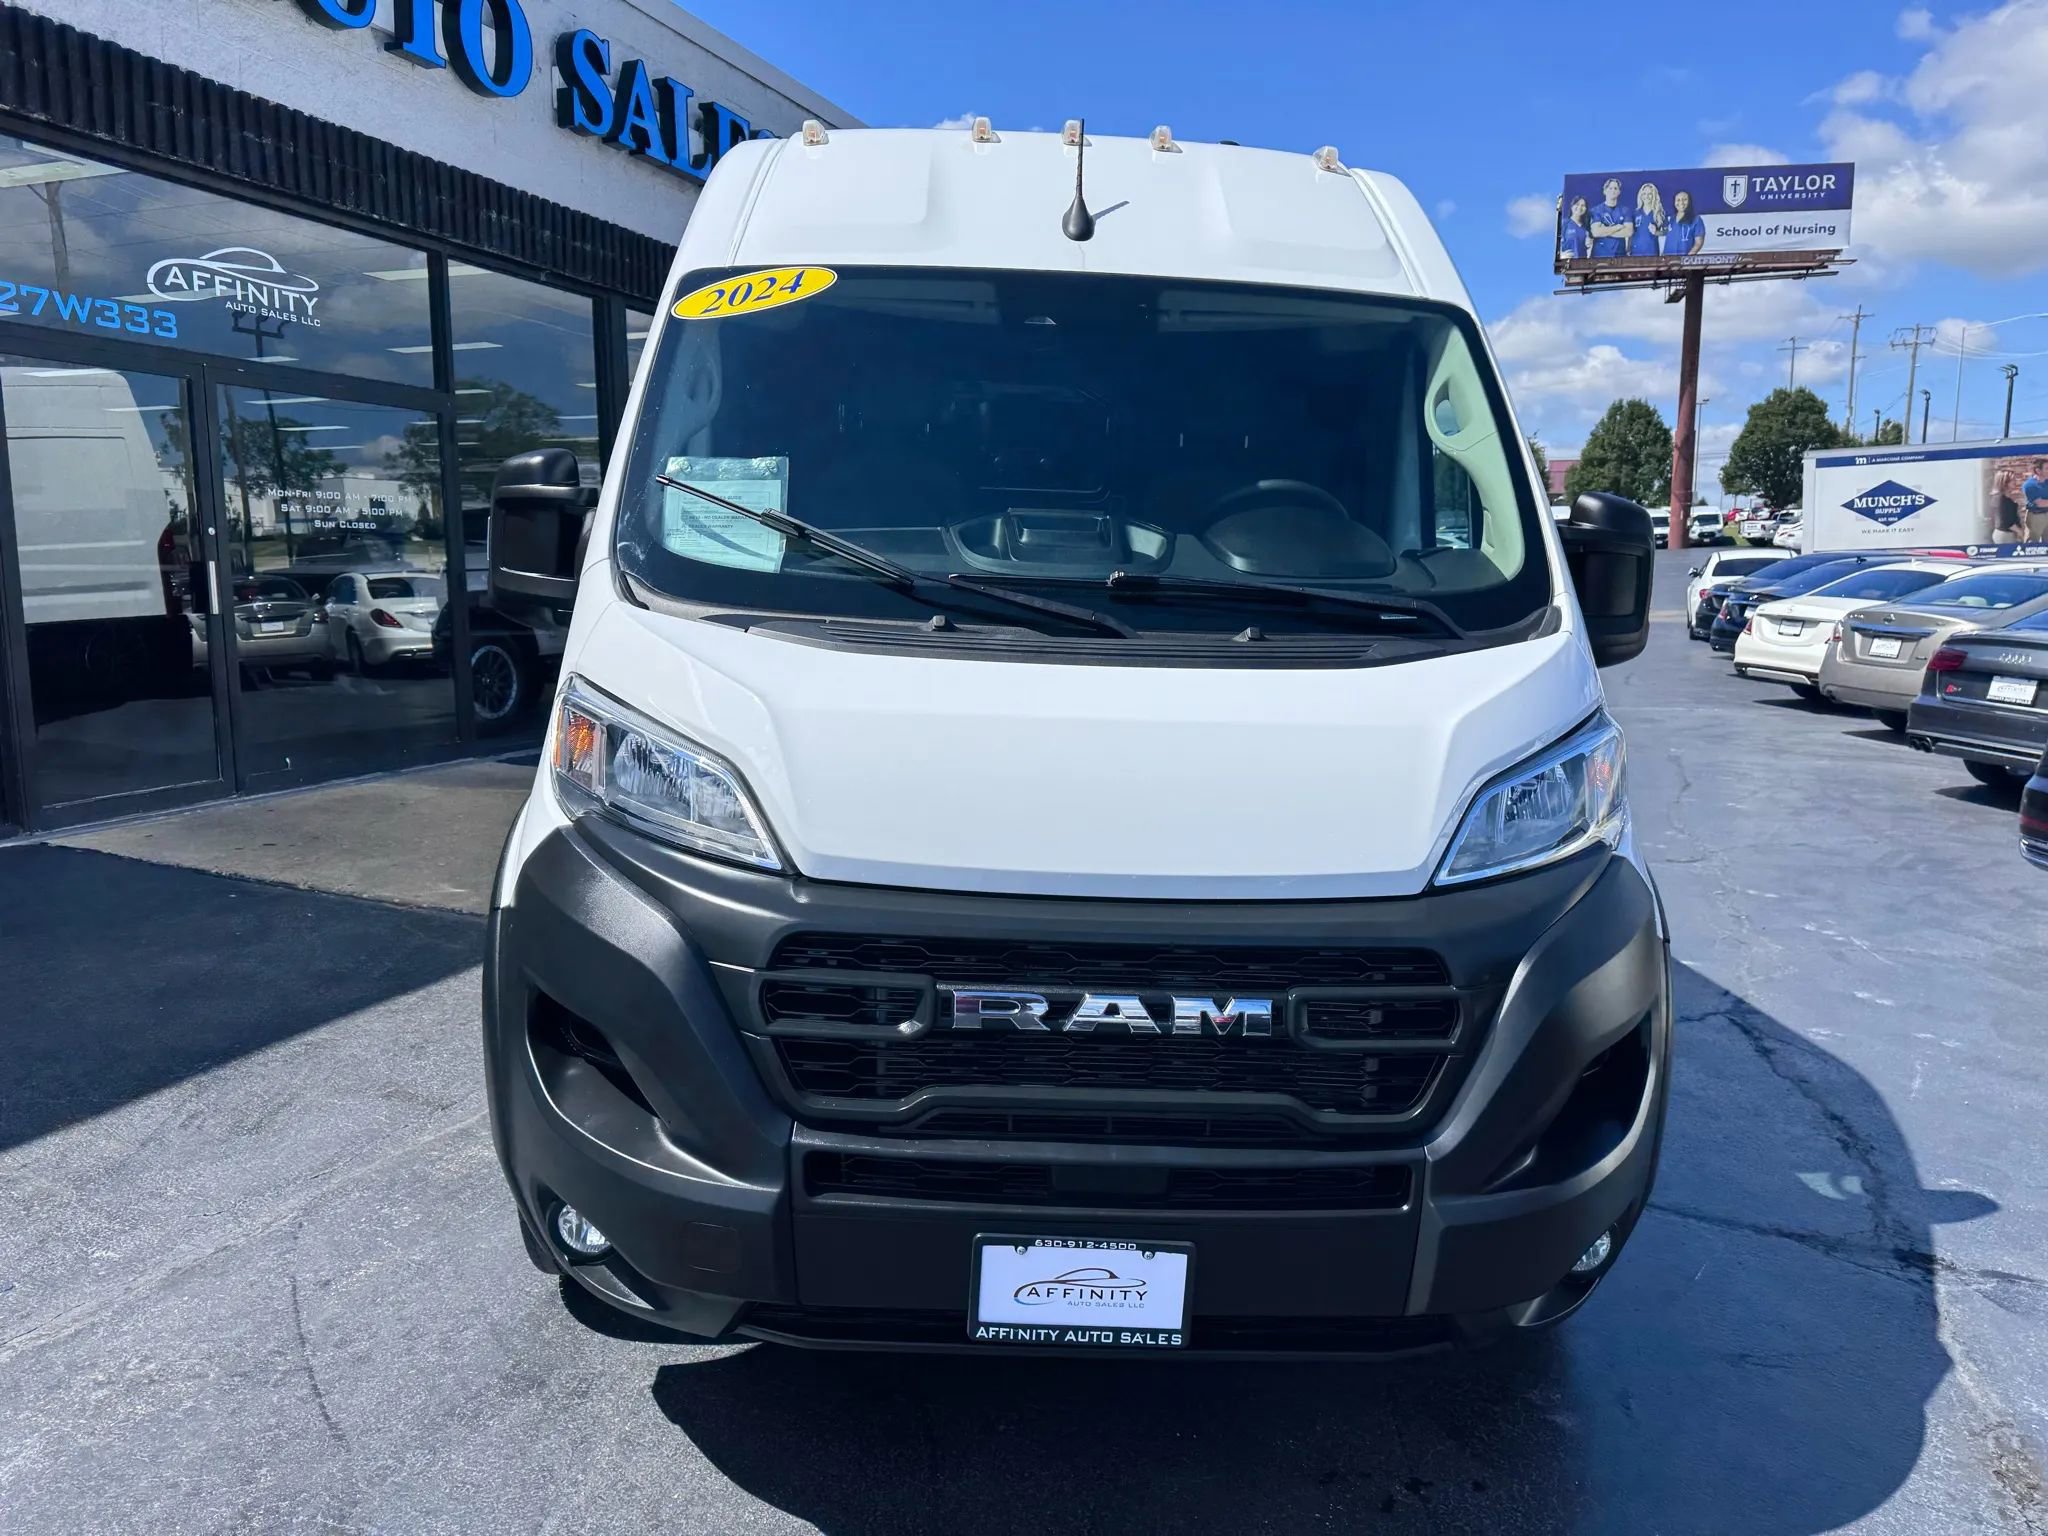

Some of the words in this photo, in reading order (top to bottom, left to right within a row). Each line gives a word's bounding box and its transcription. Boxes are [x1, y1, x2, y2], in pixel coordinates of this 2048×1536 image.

[302, 0, 533, 97] TO
[557, 28, 783, 186] SALE
[1752, 174, 1836, 193] TAYLOR
[1760, 192, 1826, 200] UNIVERSITY
[1716, 226, 1761, 237] School
[1766, 224, 1778, 235] of
[1783, 223, 1836, 236] Nursing
[164, 265, 319, 316] AFFINITY
[700, 269, 806, 315] 2024
[225, 300, 257, 314] AUTO
[260, 308, 297, 323] SALES
[301, 316, 321, 327] LLC
[316, 490, 341, 500] 9:00
[345, 492, 360, 501] AM
[371, 494, 394, 503] 7:00
[1853, 494, 1925, 509] MUNCH'S
[305, 505, 331, 514] 9:00
[335, 506, 350, 514] AM
[362, 508, 385, 516] 5:00
[389, 509, 403, 517] PM
[952, 989, 1273, 1036] RAM
[1034, 1239, 1137, 1251] 630-912-4500
[1027, 1286, 1148, 1301] AFFINITY
[976, 1326, 1060, 1342] AFFINITY
[1064, 1330, 1113, 1344] AUTO
[1120, 1332, 1183, 1346] SALES
